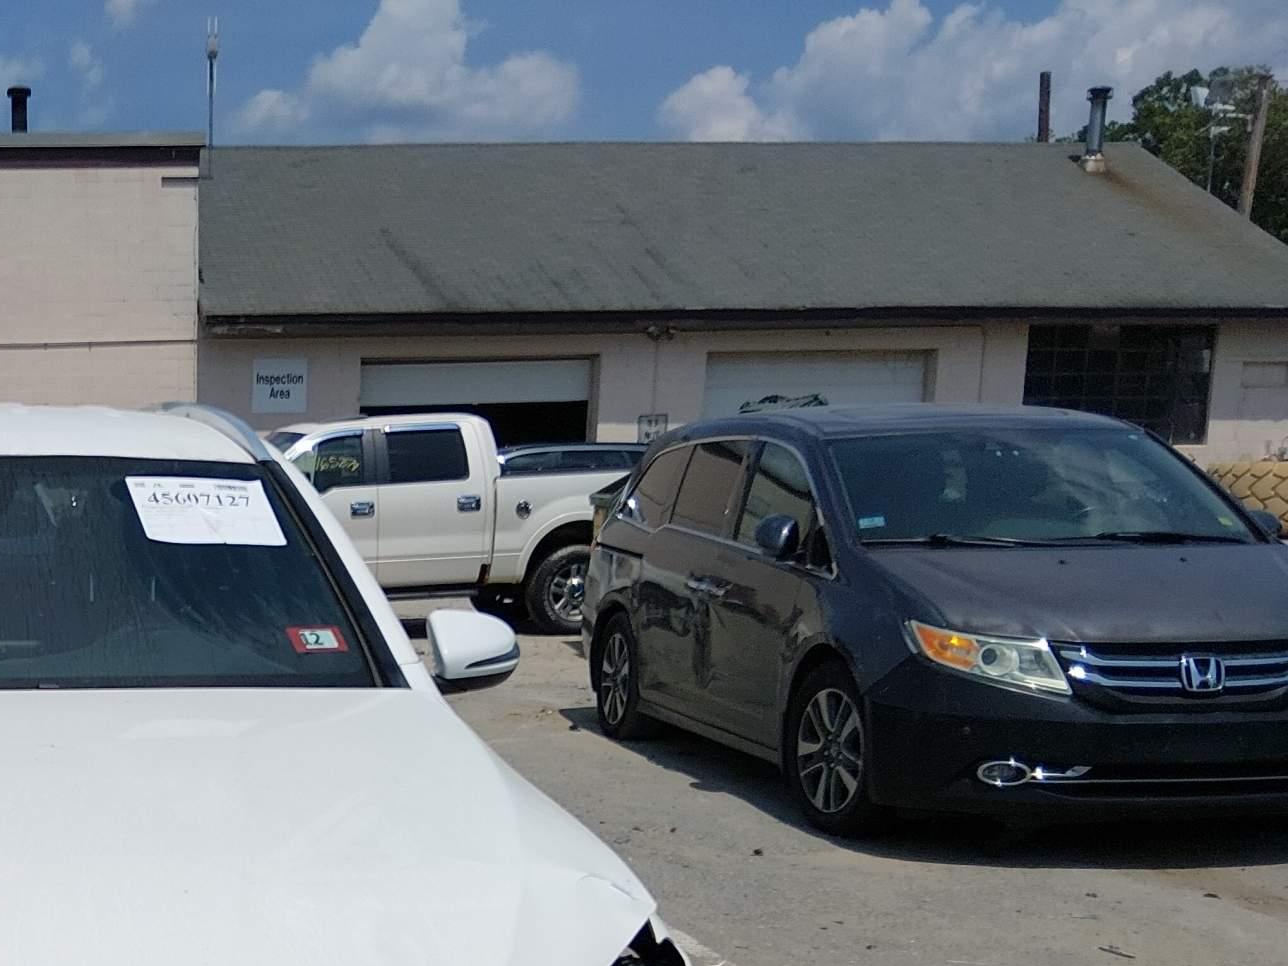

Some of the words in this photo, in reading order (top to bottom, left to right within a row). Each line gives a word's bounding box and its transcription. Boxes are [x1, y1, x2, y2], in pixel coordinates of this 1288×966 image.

[256, 372, 304, 386] Inspection
[269, 387, 290, 400] Area
[147, 491, 250, 507] 45607127
